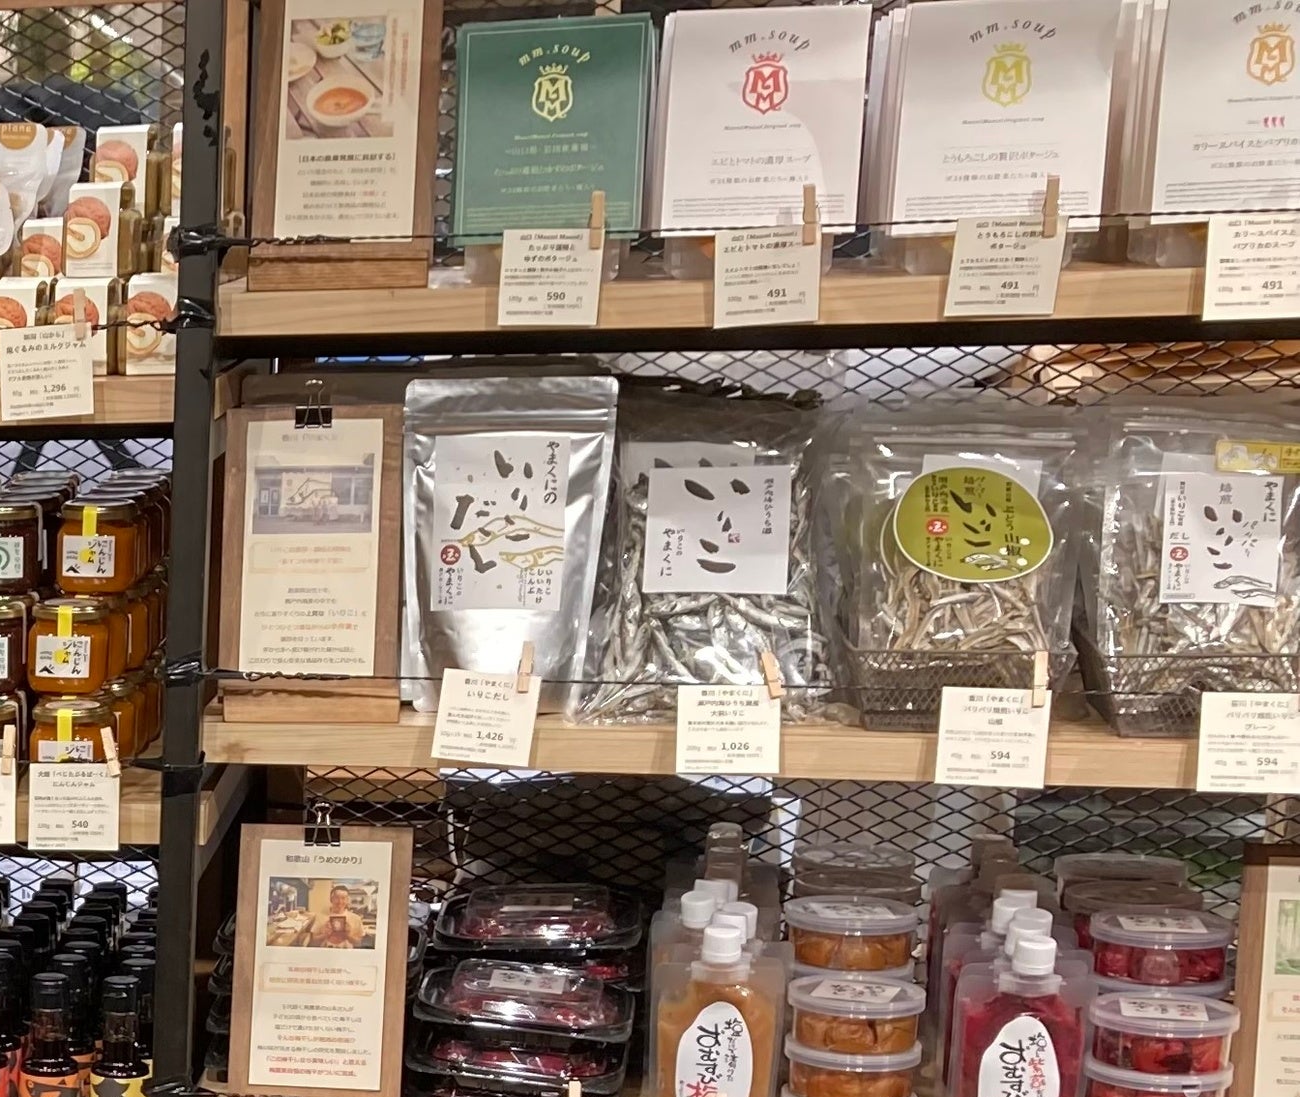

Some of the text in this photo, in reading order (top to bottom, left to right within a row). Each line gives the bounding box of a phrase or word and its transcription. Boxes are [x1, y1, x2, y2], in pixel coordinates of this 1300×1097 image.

[969, 18, 1057, 44] mm.soup
[728, 30, 812, 53] mm.soup
[519, 44, 591, 66] mm.soup
[1000, 280, 1020, 290] 491
[1262, 279, 1284, 291] 491
[546, 291, 566, 301] 590
[767, 288, 787, 298] 491
[43, 383, 66, 393] 1,296
[544, 441, 560, 505] やまくにの
[1263, 481, 1279, 523] やまくに
[97, 539, 107, 574] にんじん
[660, 527, 676, 577] やまくに
[71, 640, 84, 675] にんじん
[466, 690, 510, 702] いりこだし
[476, 730, 504, 742] 1,426
[721, 742, 750, 751] 1,026
[990, 751, 1011, 760] 594
[1256, 757, 1279, 766] 594
[72, 820, 88, 828] 540
